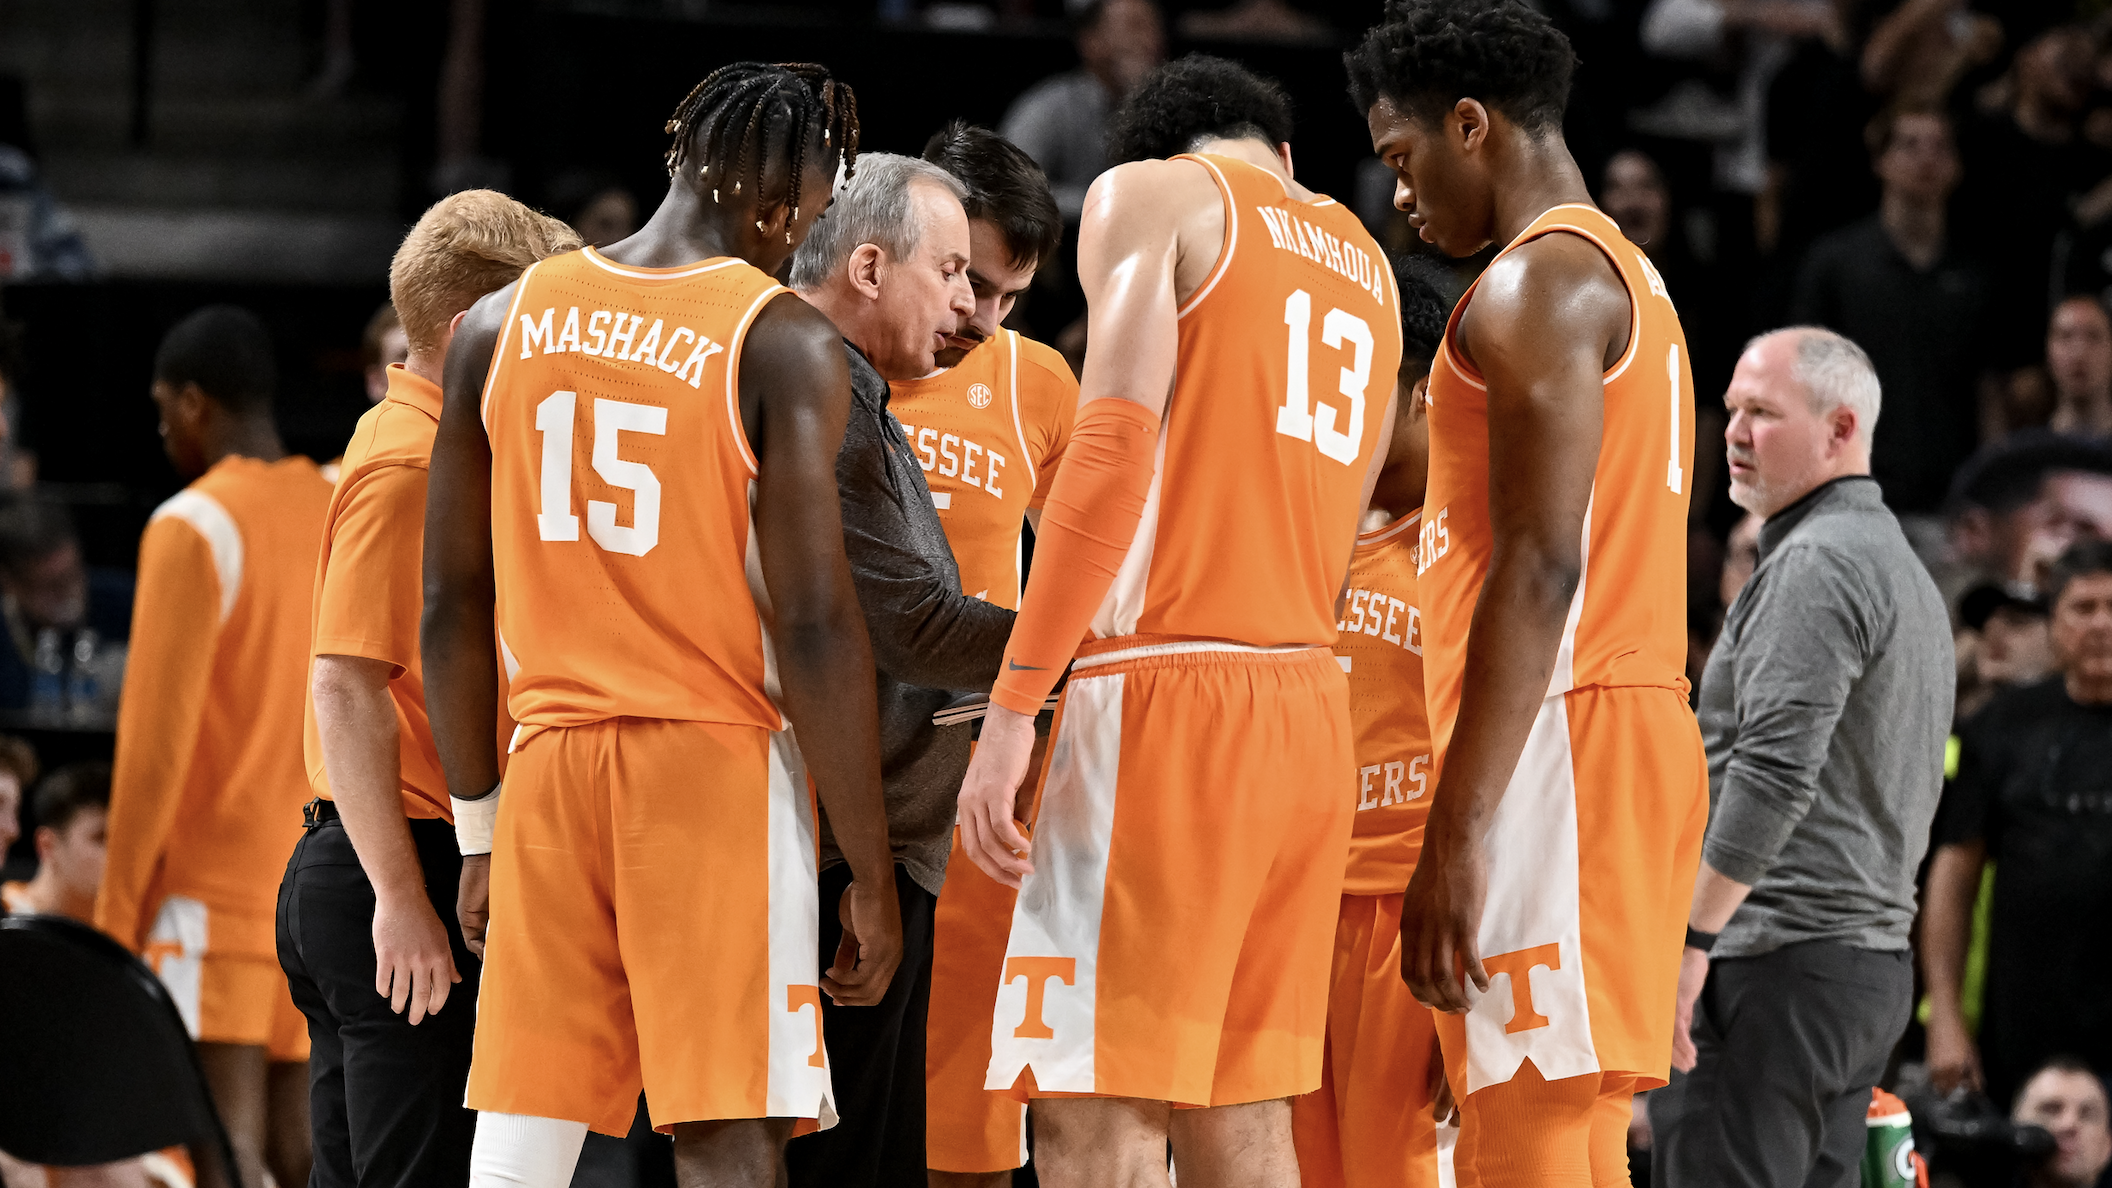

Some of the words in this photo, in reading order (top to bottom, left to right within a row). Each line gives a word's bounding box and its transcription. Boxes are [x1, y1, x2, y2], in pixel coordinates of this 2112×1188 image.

[1257, 206, 1384, 306] NKAMHOUA
[520, 306, 724, 389] MASHACK
[1276, 288, 1375, 467] 13
[969, 385, 991, 407] SEC
[1666, 342, 1683, 495] 1
[535, 390, 668, 557] 15
[1417, 506, 1450, 577] ERS
[1357, 753, 1430, 812] ERS
[1004, 956, 1076, 1040] T
[1480, 942, 1561, 1035] T
